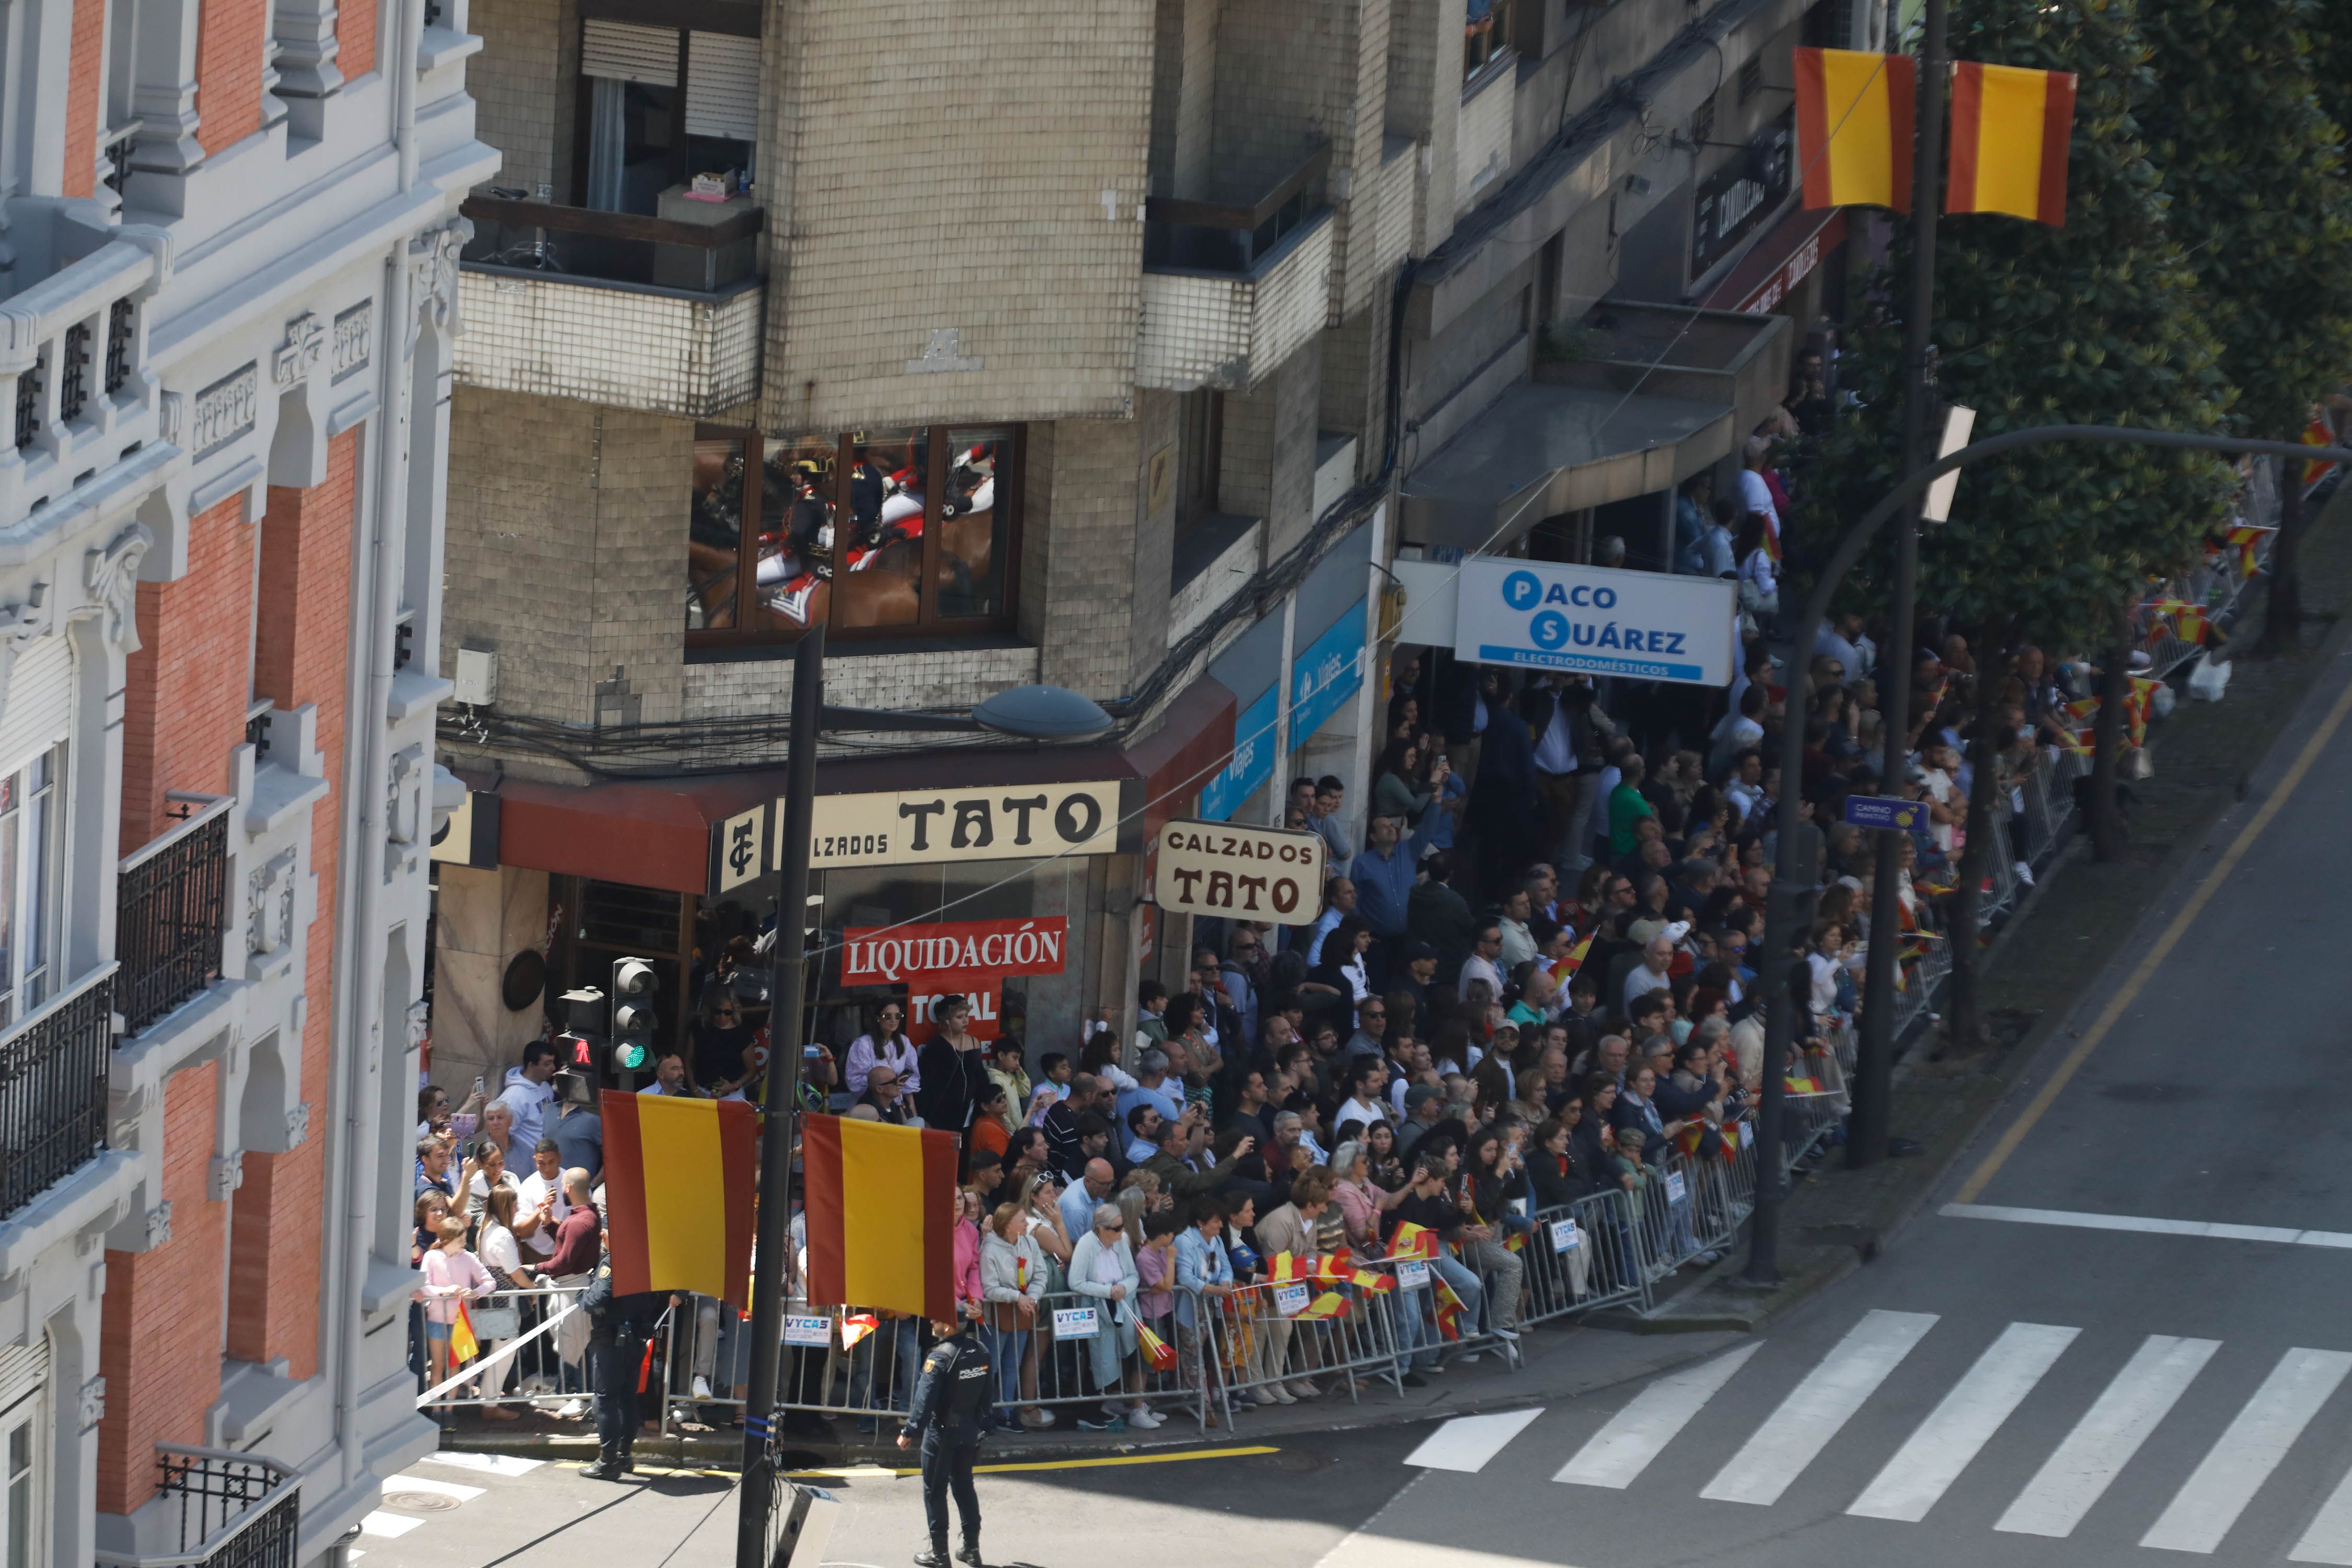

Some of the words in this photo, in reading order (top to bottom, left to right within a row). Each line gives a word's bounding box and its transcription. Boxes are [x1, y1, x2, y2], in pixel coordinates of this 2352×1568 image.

[1514, 579, 1618, 609] PACO
[1542, 619, 1687, 655] SUÁREZ
[1514, 652, 1669, 676] ELECTRODOMÉSTICOS
[1856, 812, 1890, 821] PRIMITIVO
[1857, 804, 1891, 814] CAMINO
[814, 834, 888, 857] LZADOS
[899, 793, 1102, 851] TATO
[1168, 832, 1312, 864] CALZADOS
[1174, 867, 1300, 913] TATO
[847, 921, 1062, 981] LIQUIDACIÓN
[912, 991, 997, 1024] TOAL
[1278, 1287, 1306, 1300] VYCAS
[786, 1318, 828, 1329] VYCAS
[1057, 1310, 1094, 1323] VYCAS
